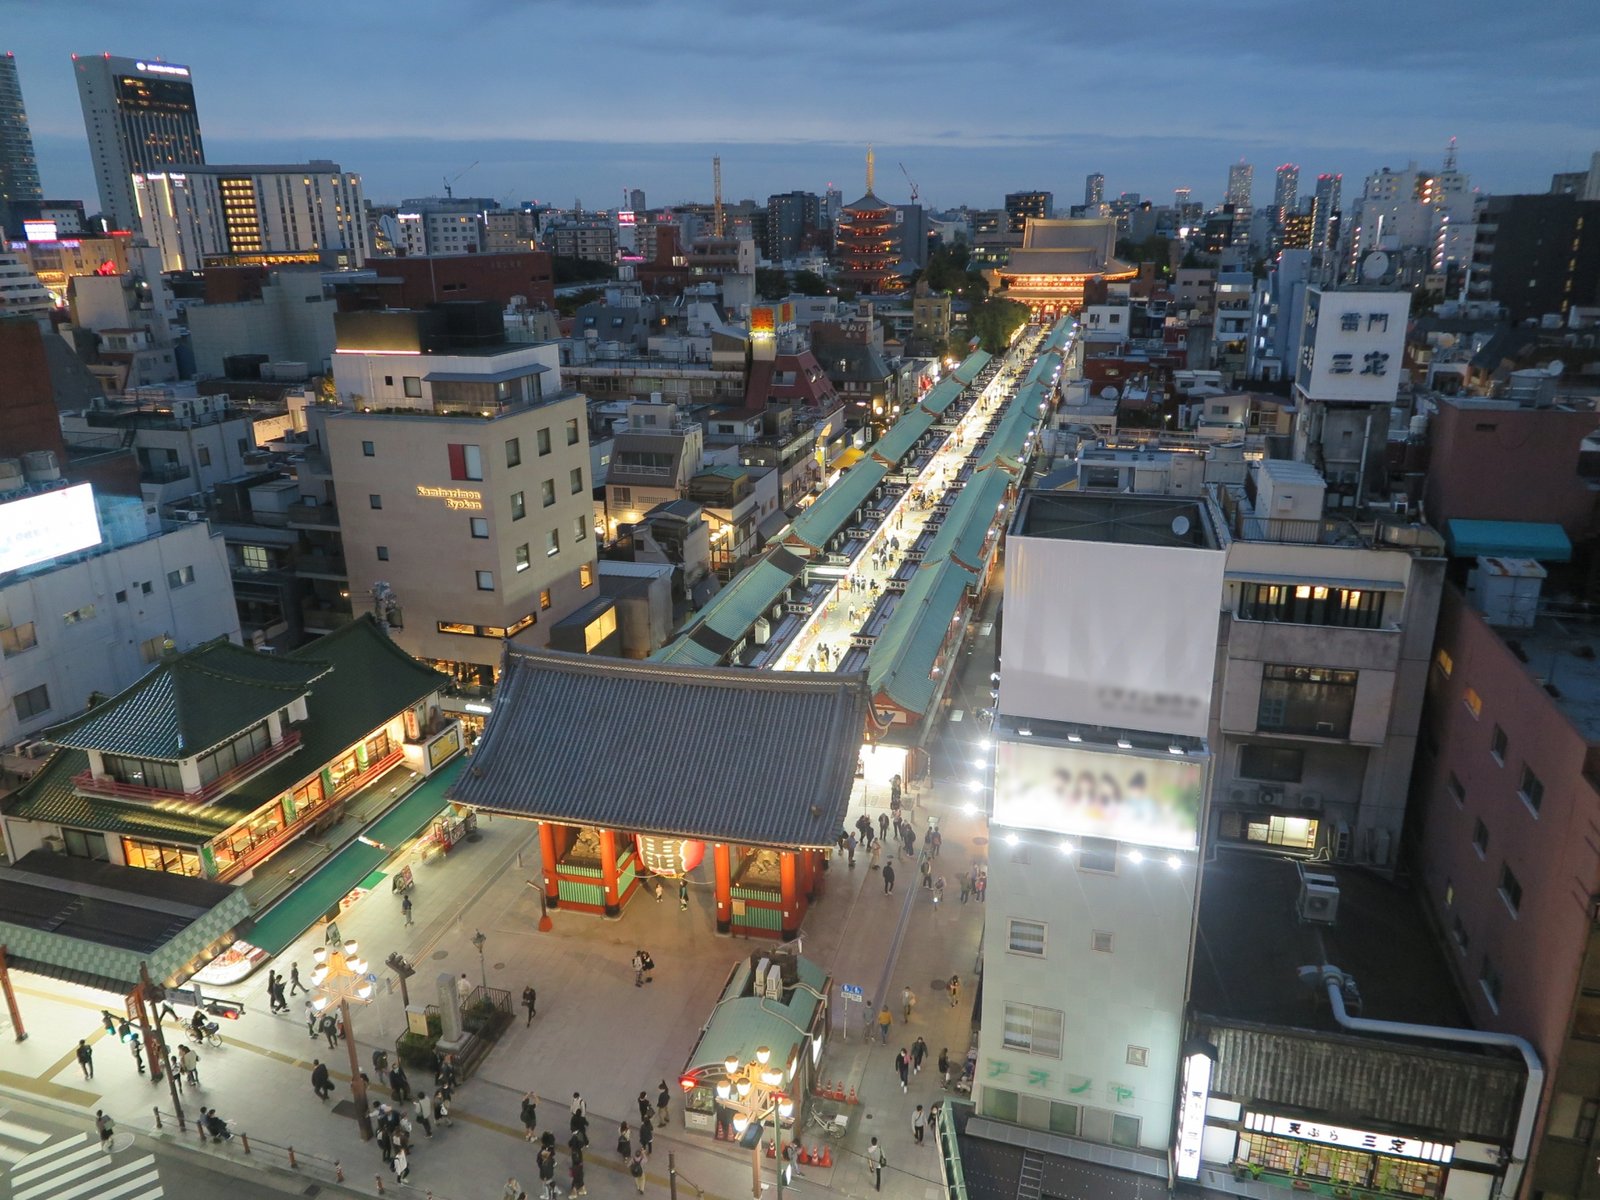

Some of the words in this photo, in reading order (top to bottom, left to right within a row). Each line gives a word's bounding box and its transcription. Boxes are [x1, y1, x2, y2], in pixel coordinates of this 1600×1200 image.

[1340, 312, 1389, 333] 雷門
[1328, 350, 1390, 377] 三定
[416, 486, 481, 499] Kaminarimon
[445, 498, 482, 510] Ryokan
[988, 1061, 1133, 1102] アオノヤ
[1288, 1122, 1339, 1141] 天ぷら
[1362, 1134, 1406, 1153] 三定
